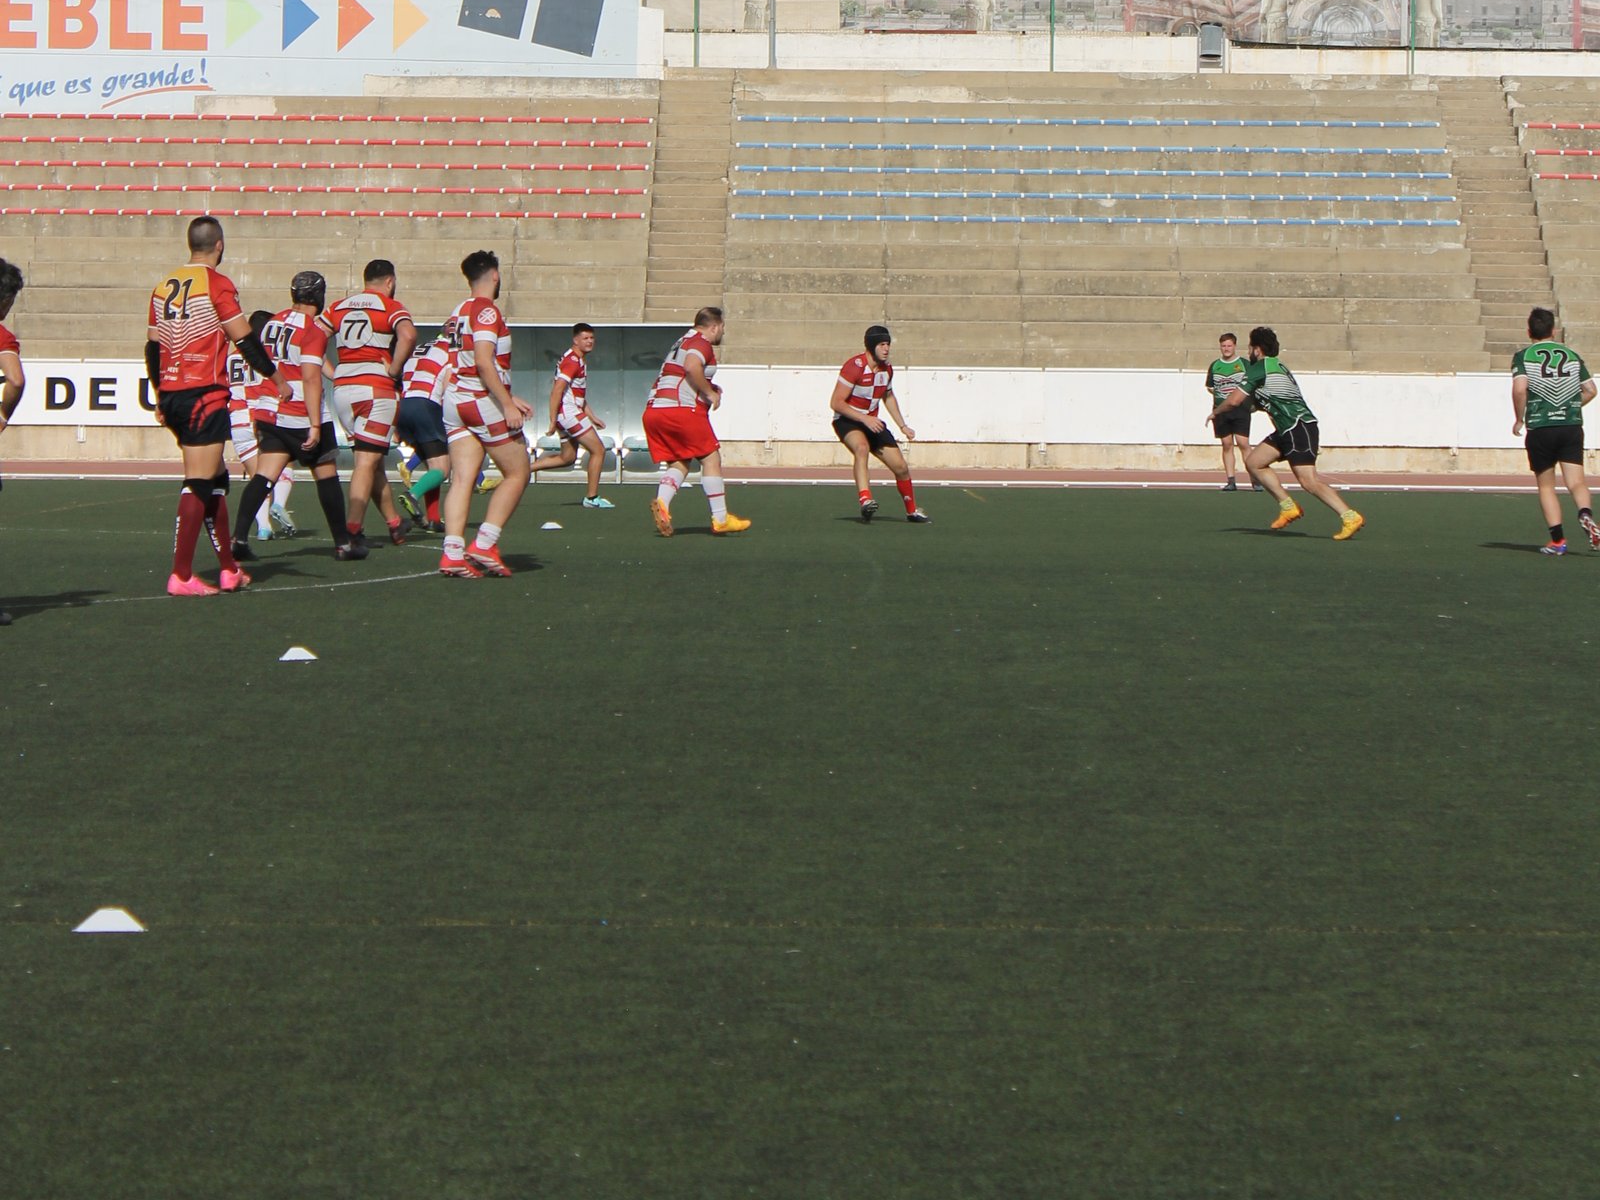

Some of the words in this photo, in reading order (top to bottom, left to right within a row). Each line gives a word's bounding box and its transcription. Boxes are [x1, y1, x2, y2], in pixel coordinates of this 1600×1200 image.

[8, 79, 56, 107] que
[64, 76, 92, 95] es
[101, 57, 209, 98] grande!
[163, 278, 194, 321] 21
[264, 323, 296, 361] 41
[343, 319, 369, 341] 77
[229, 357, 257, 384] 61
[1536, 349, 1571, 378] 22
